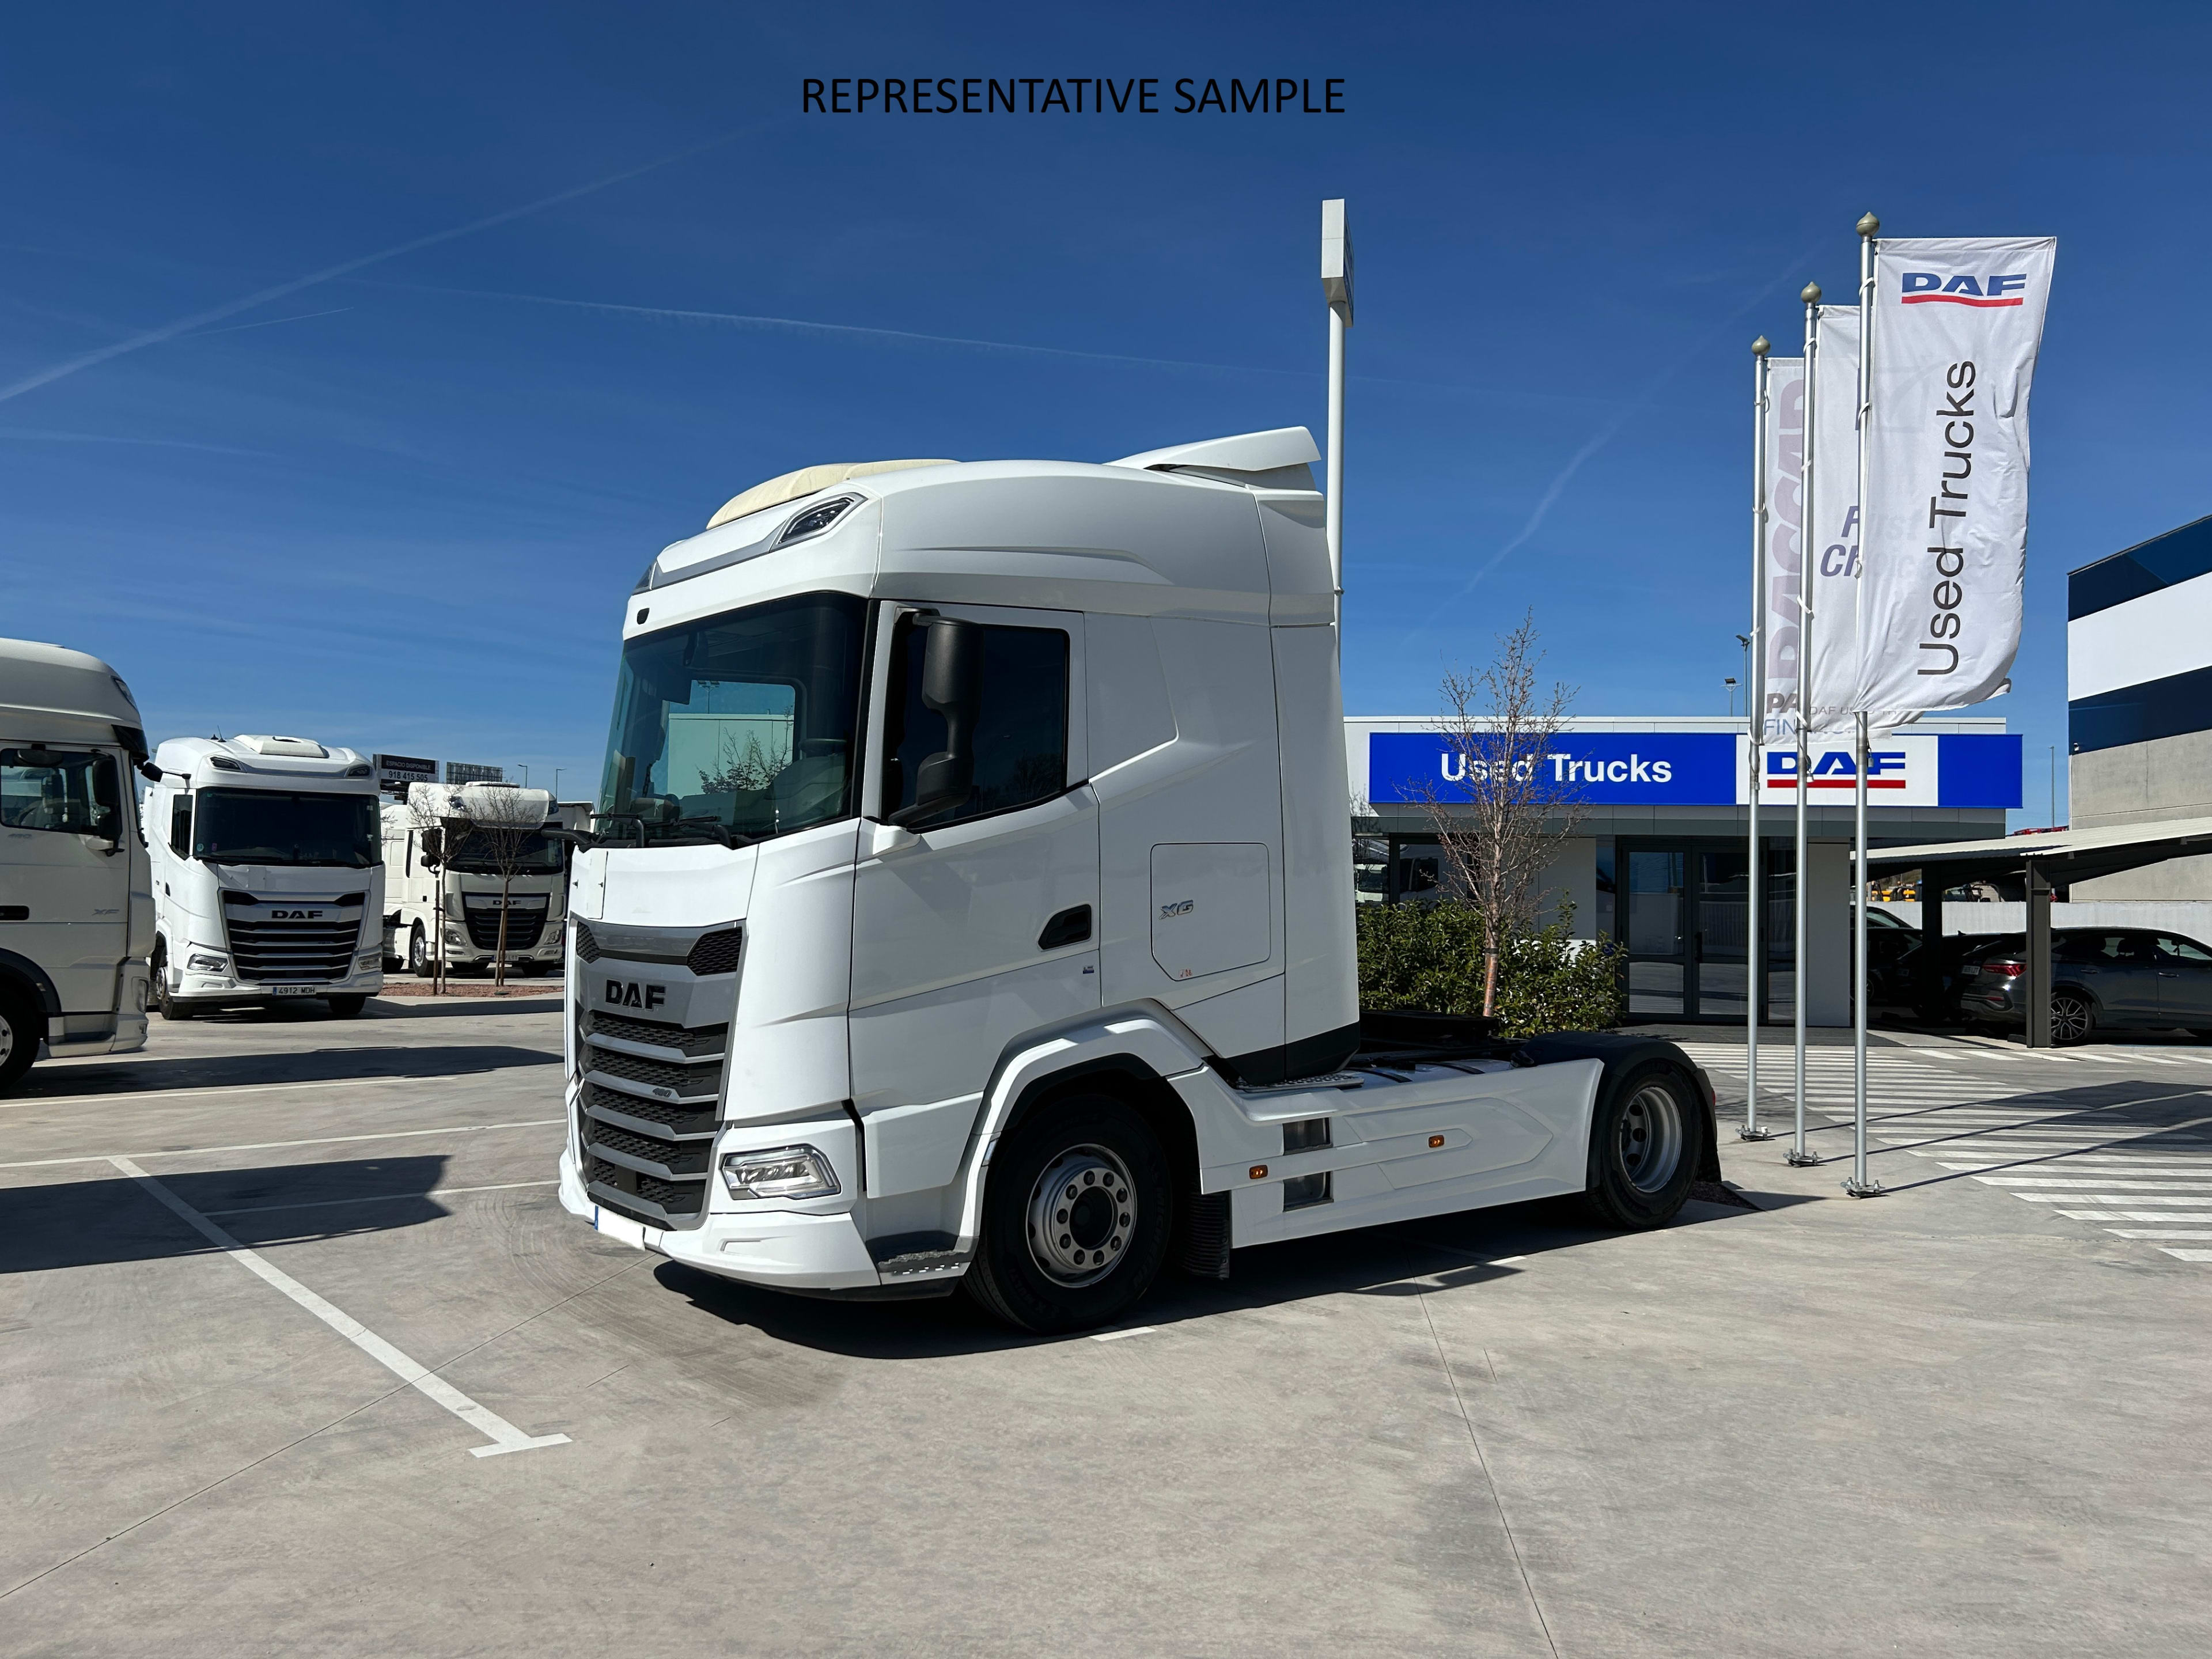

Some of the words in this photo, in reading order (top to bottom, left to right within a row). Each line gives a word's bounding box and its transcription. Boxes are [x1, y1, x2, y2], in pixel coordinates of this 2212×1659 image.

[1902, 272, 2027, 296] DAF
[1929, 359, 1976, 528] Trucks
[1917, 547, 1964, 675] Used
[1809, 706, 1836, 715] DAF
[406, 762, 431, 770] DISPONIBLE
[1441, 753, 1533, 782] Used
[1547, 753, 1672, 782] Trucks
[1767, 752, 1906, 775] DAF
[389, 770, 401, 779] 918
[416, 774, 428, 782] 505
[272, 910, 323, 919] DAF
[1159, 899, 1194, 920] XG
[605, 979, 666, 1011] DAF
